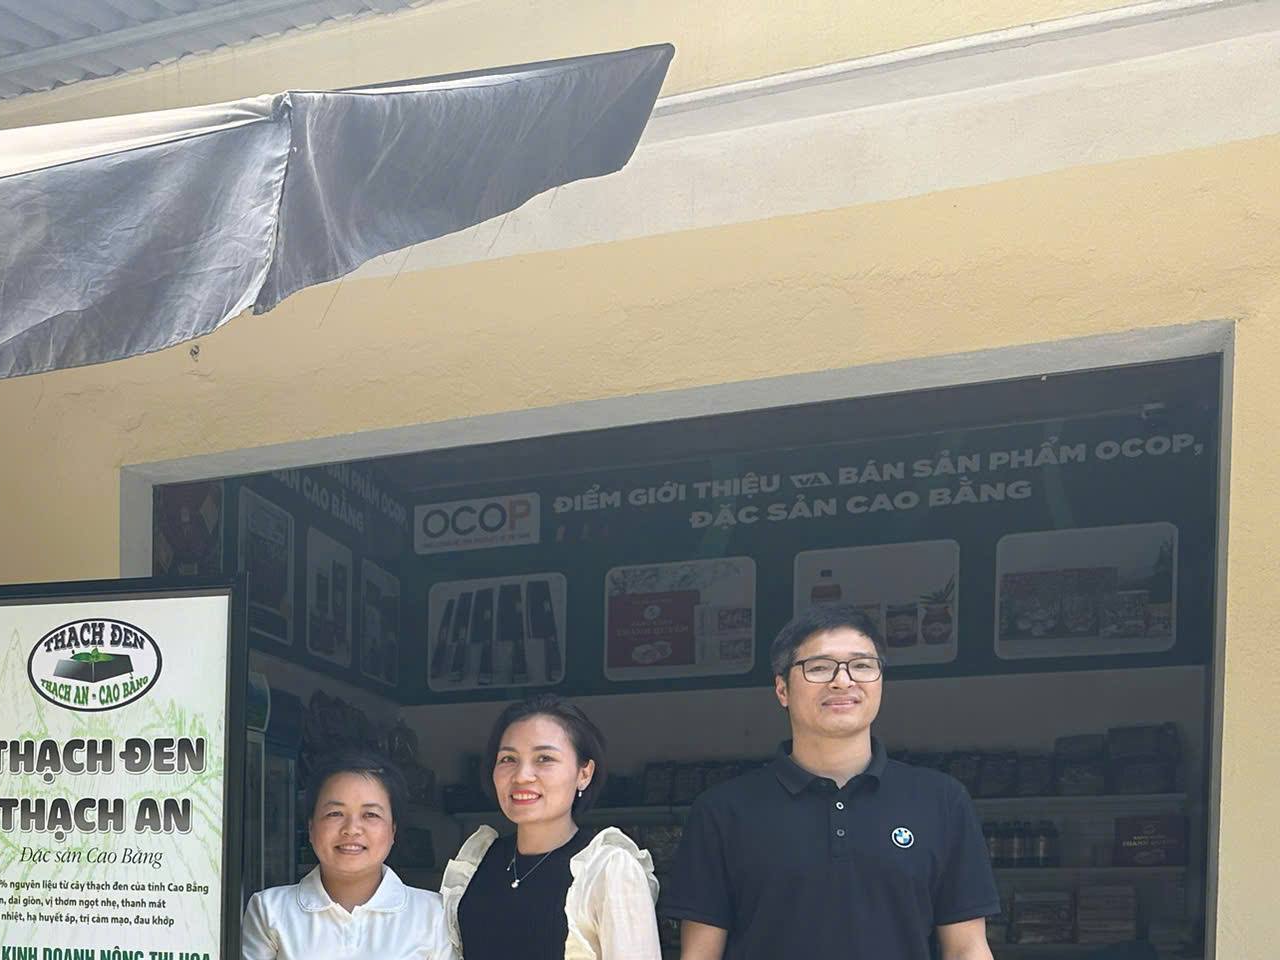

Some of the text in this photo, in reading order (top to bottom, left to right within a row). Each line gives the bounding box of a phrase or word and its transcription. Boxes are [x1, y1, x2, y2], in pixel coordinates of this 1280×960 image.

[552, 432, 1204, 513] ĐIỂM GIỚI THIỆU BÁN SẢN PHẨM OCOP,
[422, 496, 531, 538] OCOP
[688, 473, 1033, 530] ĐẶC SẢN CAO BẰNG
[43, 622, 146, 654] THẠCH ĐEN
[74, 686, 90, 706] AN
[99, 683, 121, 705] CAO
[119, 736, 206, 774] ĐEN
[135, 797, 193, 834] AN
[20, 847, 163, 869] Đặc sản Cao Bằng
[8, 895, 21, 905] dai
[45, 897, 53, 908] vị
[55, 896, 77, 907] thơm
[78, 898, 99, 909] ngọt
[121, 899, 147, 909] thanh
[148, 898, 167, 909] mát
[10, 880, 41, 891] nguyên
[42, 880, 58, 891] liệu
[86, 881, 110, 893] thạch
[112, 881, 129, 891] đen
[130, 881, 146, 892] của
[167, 883, 184, 893] Cao
[1, 912, 25, 923] nhiệt,
[26, 912, 37, 923] hạ
[111, 915, 132, 926] mạo,
[133, 915, 150, 925] đau
